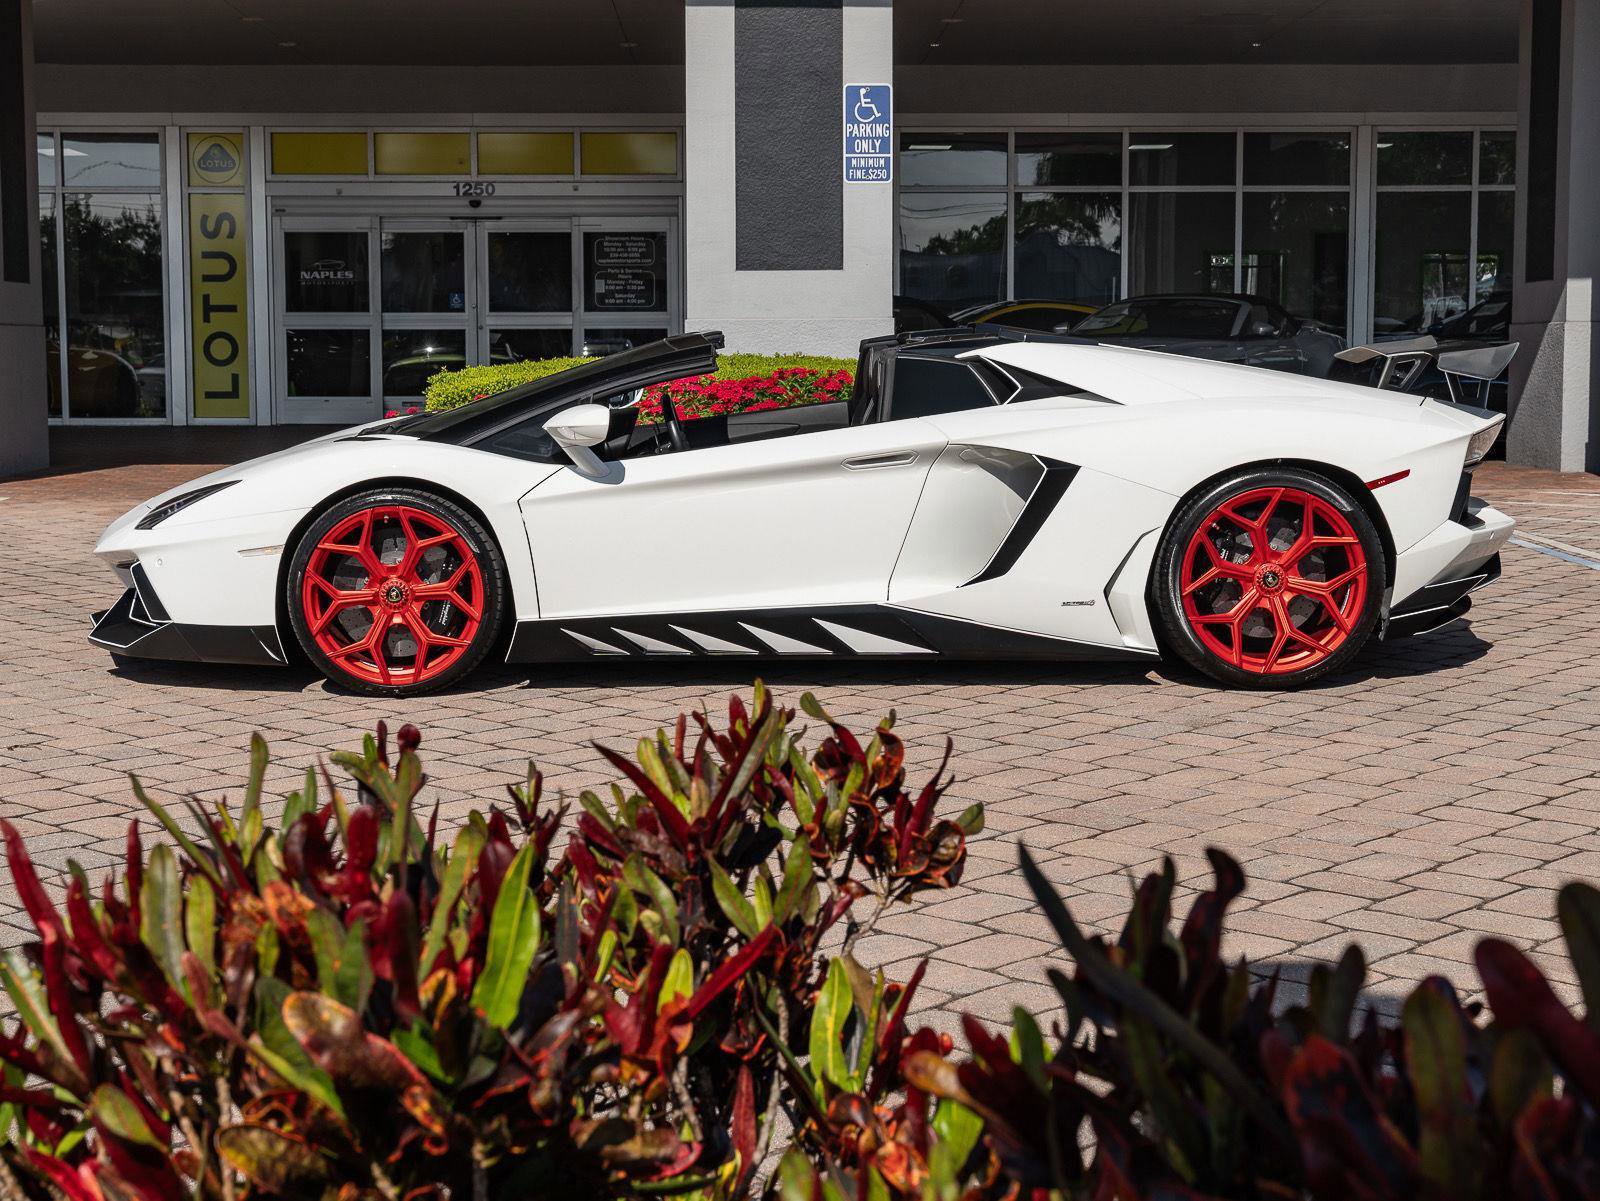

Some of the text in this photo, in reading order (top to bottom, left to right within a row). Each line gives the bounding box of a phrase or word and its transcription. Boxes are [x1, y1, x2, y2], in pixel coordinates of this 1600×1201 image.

[846, 123, 890, 138] PARKING
[854, 139, 881, 153] ONLY
[201, 160, 234, 168] LOTUS
[851, 157, 885, 168] MINIMUM
[849, 168, 887, 180] FINE $250
[453, 181, 496, 196] 1250
[300, 271, 354, 279] NAPLES
[200, 211, 239, 399] LOTUS
